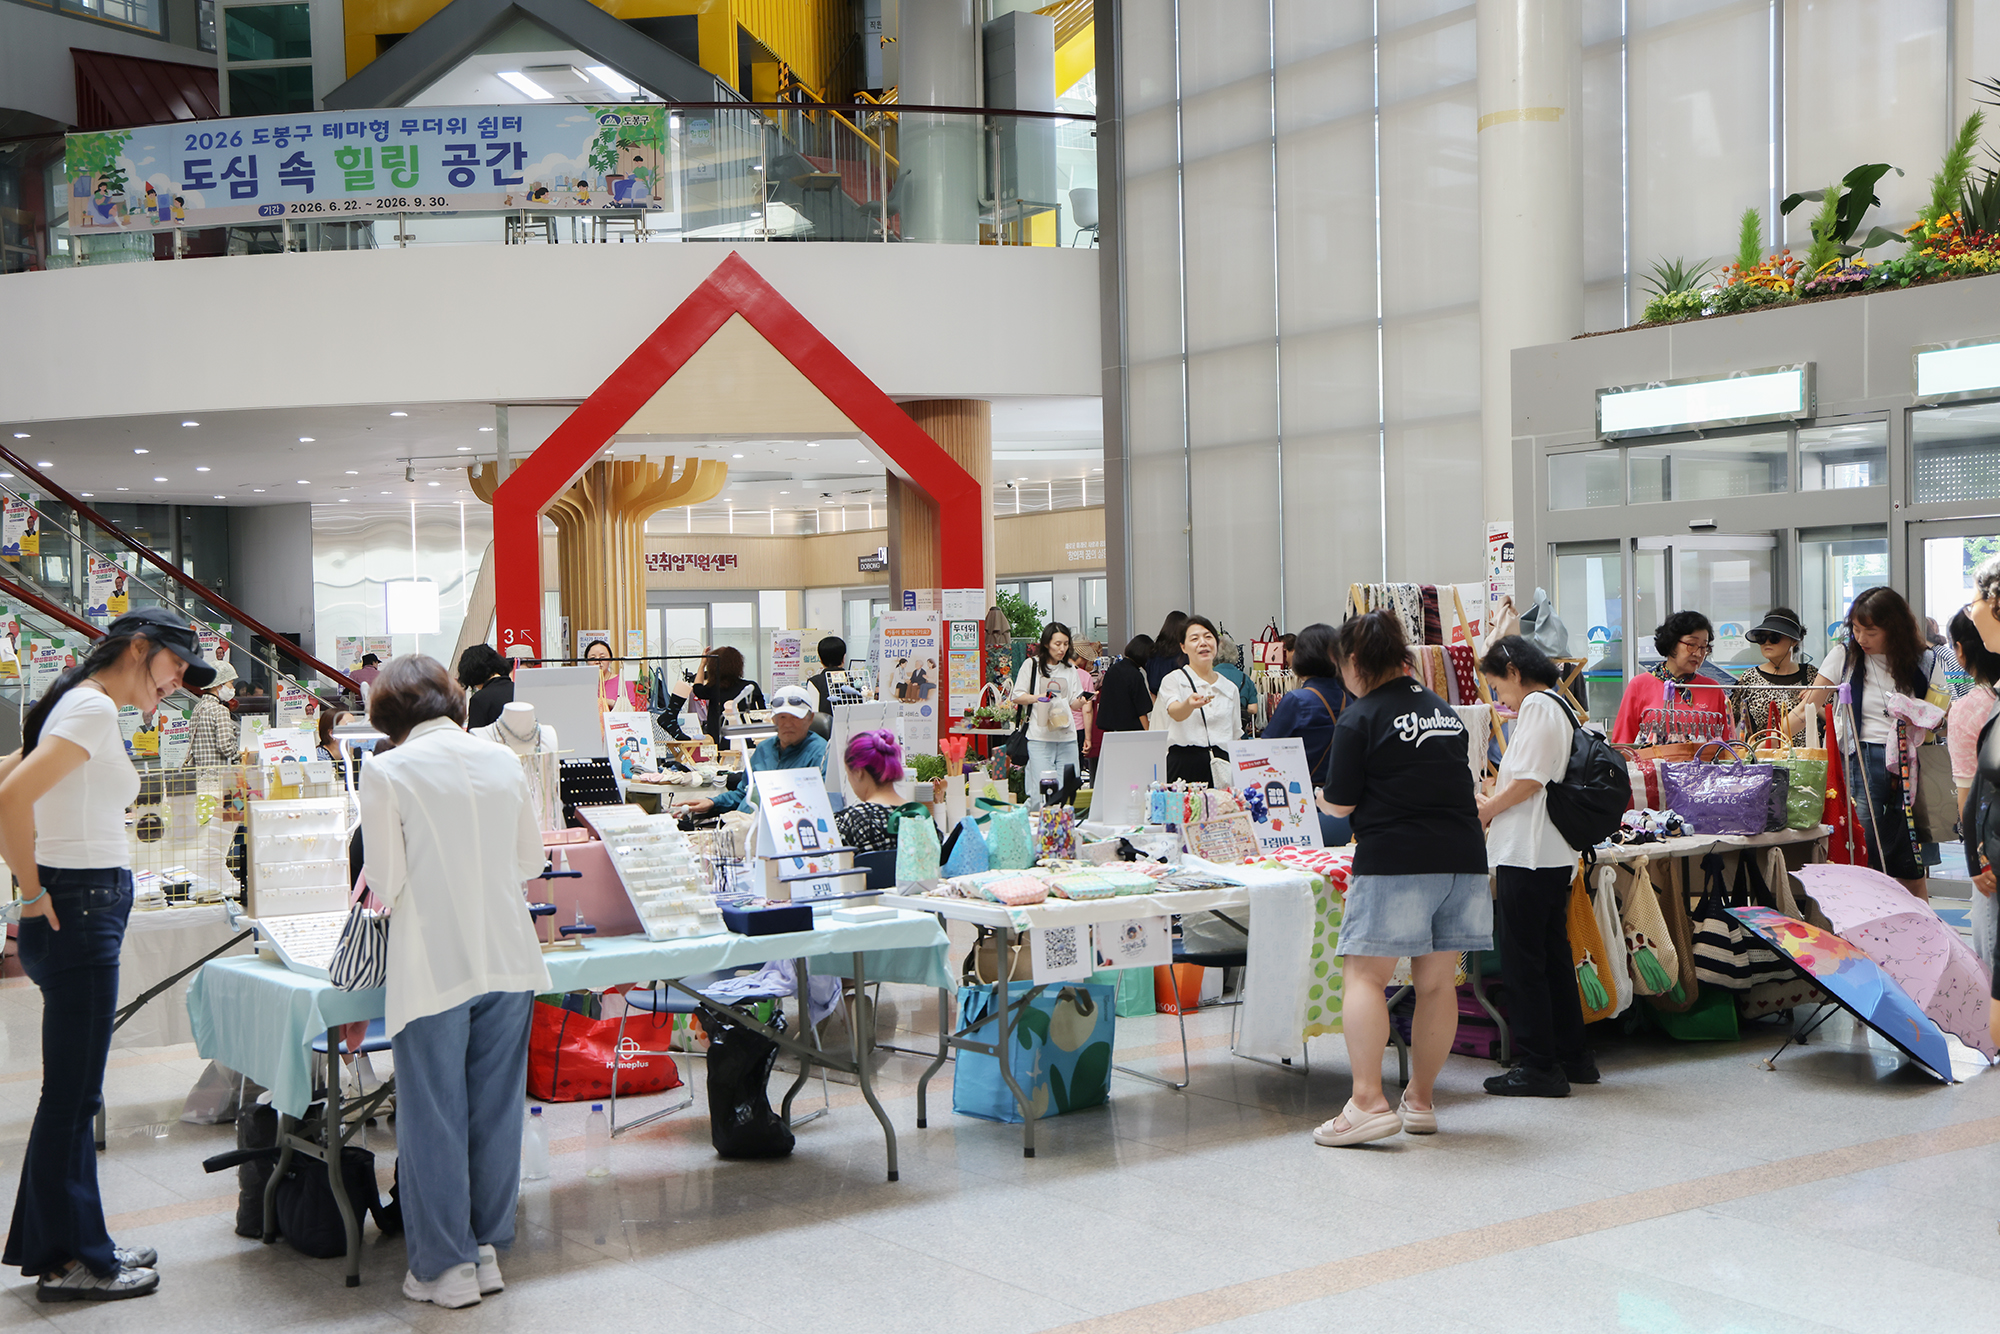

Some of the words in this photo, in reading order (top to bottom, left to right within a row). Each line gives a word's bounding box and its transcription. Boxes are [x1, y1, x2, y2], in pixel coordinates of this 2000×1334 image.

[622, 114, 650, 127] 도봉구
[185, 130, 243, 151] 2026
[252, 124, 313, 148] 도봉구
[322, 120, 390, 143] 테마형
[400, 118, 467, 136] 무더위
[477, 116, 522, 140] 쉼터
[182, 154, 258, 200] 도심
[278, 150, 316, 194] 속
[334, 144, 420, 192] 힐링
[442, 142, 528, 188] 공간
[263, 205, 280, 215] 기간
[290, 203, 326, 214] 2026.
[329, 202, 341, 212] 6.
[344, 200, 362, 210] 22.
[376, 197, 410, 208] 2026.
[414, 197, 426, 208] 9.
[430, 196, 449, 207] 30.
[954, 624, 976, 632] 무더위
[504, 628, 514, 644] 3
[884, 638, 908, 648] 의사가
[910, 638, 934, 648] 집으로
[884, 649, 912, 658] 갑니다!
[606, 1060, 649, 1070] Hmeplus
